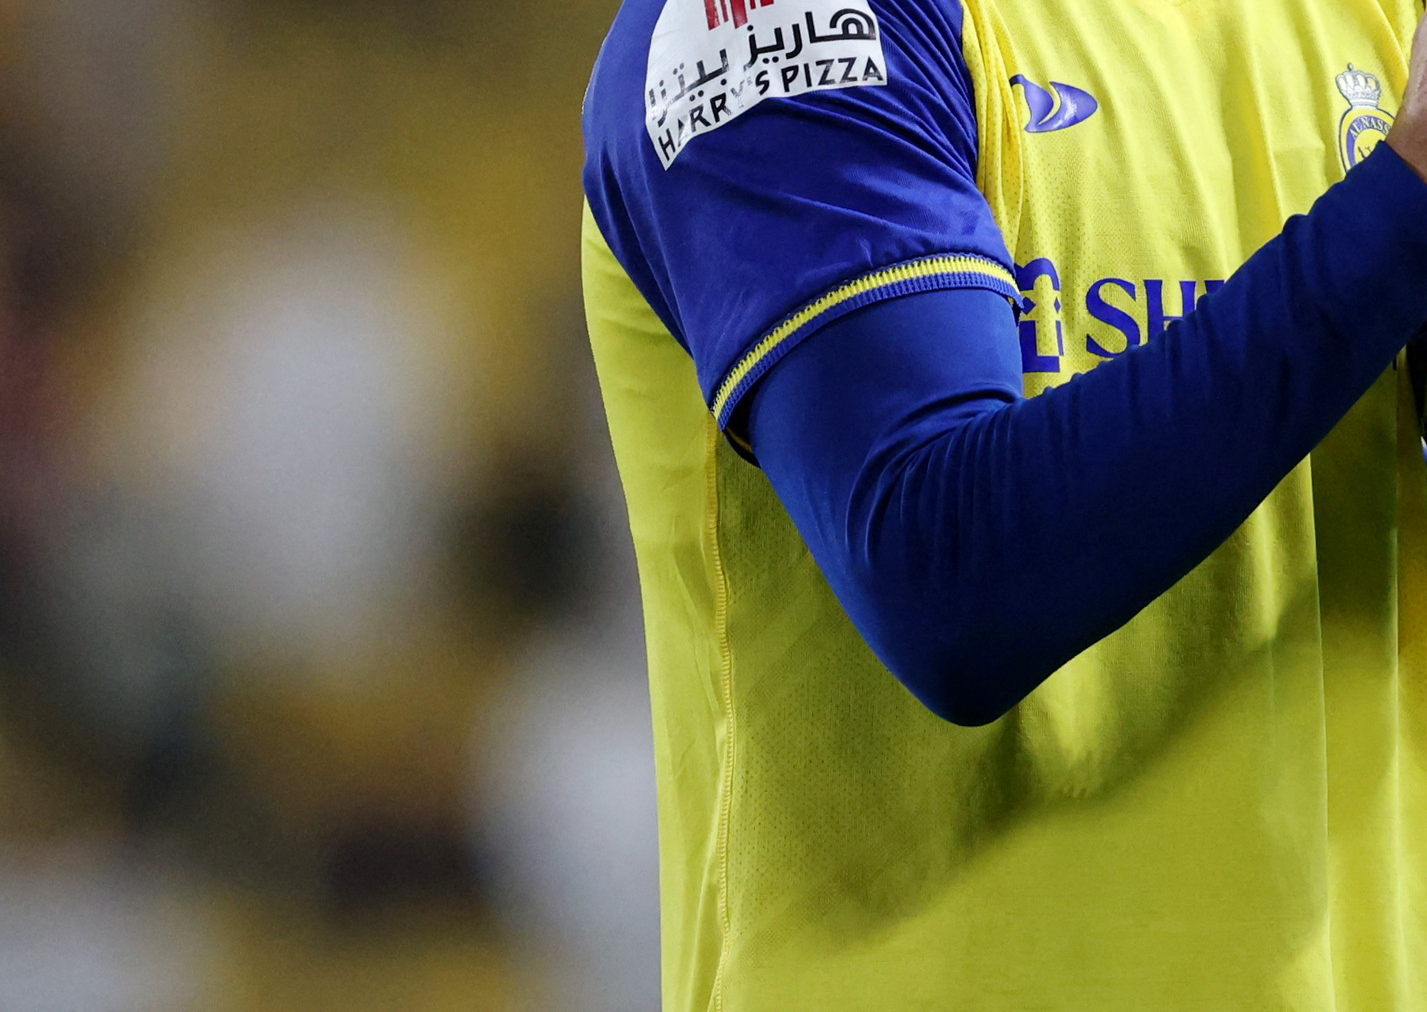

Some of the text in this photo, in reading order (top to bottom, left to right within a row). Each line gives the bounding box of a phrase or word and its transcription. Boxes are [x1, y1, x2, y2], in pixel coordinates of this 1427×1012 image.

[743, 8, 877, 72] هاريز
[780, 55, 885, 93] PIZZA
[1086, 278, 1226, 359] SH
